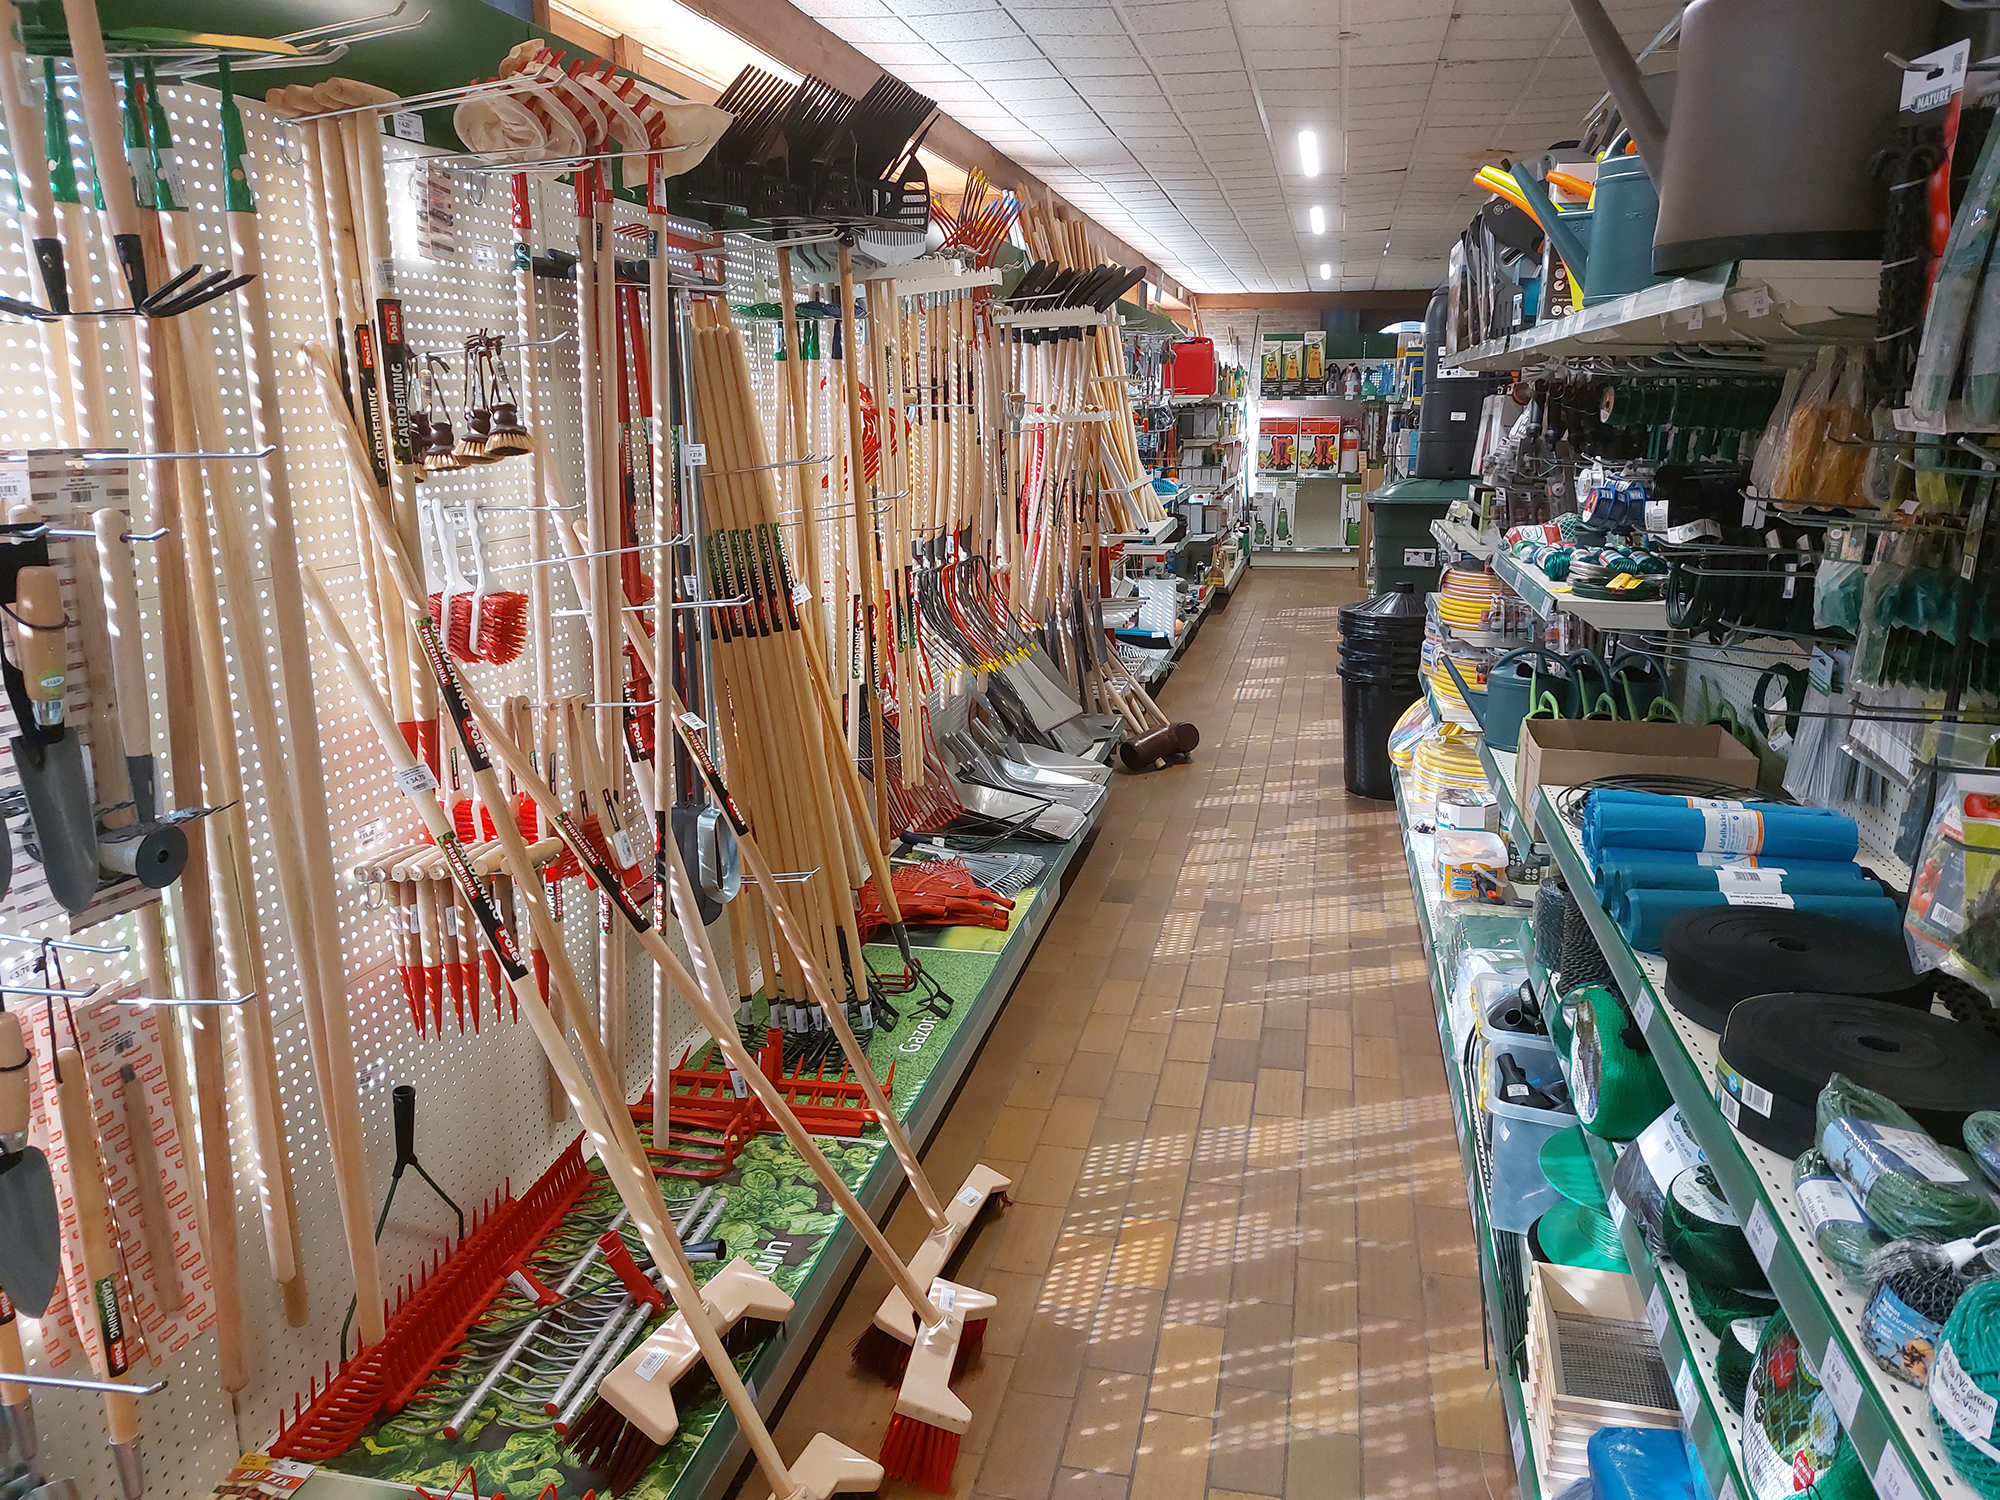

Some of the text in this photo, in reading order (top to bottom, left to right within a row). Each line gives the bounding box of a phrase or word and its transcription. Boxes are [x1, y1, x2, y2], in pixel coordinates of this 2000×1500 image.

[1916, 87, 1951, 110] NATURE
[390, 310, 399, 342] Polet
[367, 386, 387, 470] GARDENING
[391, 363, 411, 448] GARDENING
[719, 532, 736, 596] GARDENING
[421, 627, 448, 685] PROFESSIONAL
[853, 626, 861, 676] GARDENING
[871, 640, 881, 700] GARDENING
[429, 621, 489, 761] GARDENING Polet
[631, 721, 646, 754] Polet
[411, 775, 426, 785] 34,70
[562, 819, 598, 866] PROFESSIONAL
[1718, 814, 1727, 850] Abfallsäcke
[444, 841, 478, 898] PROFESSIONAL
[452, 836, 525, 968] GARDENING Polet
[621, 889, 647, 921] Polet
[898, 1016, 941, 1053] Gazon
[101, 1280, 128, 1372] GARDENING Polet
[1954, 1373, 1969, 1393] PVC
[1966, 1389, 1994, 1414] Groen
[1888, 1472, 1901, 1497] 9,75
